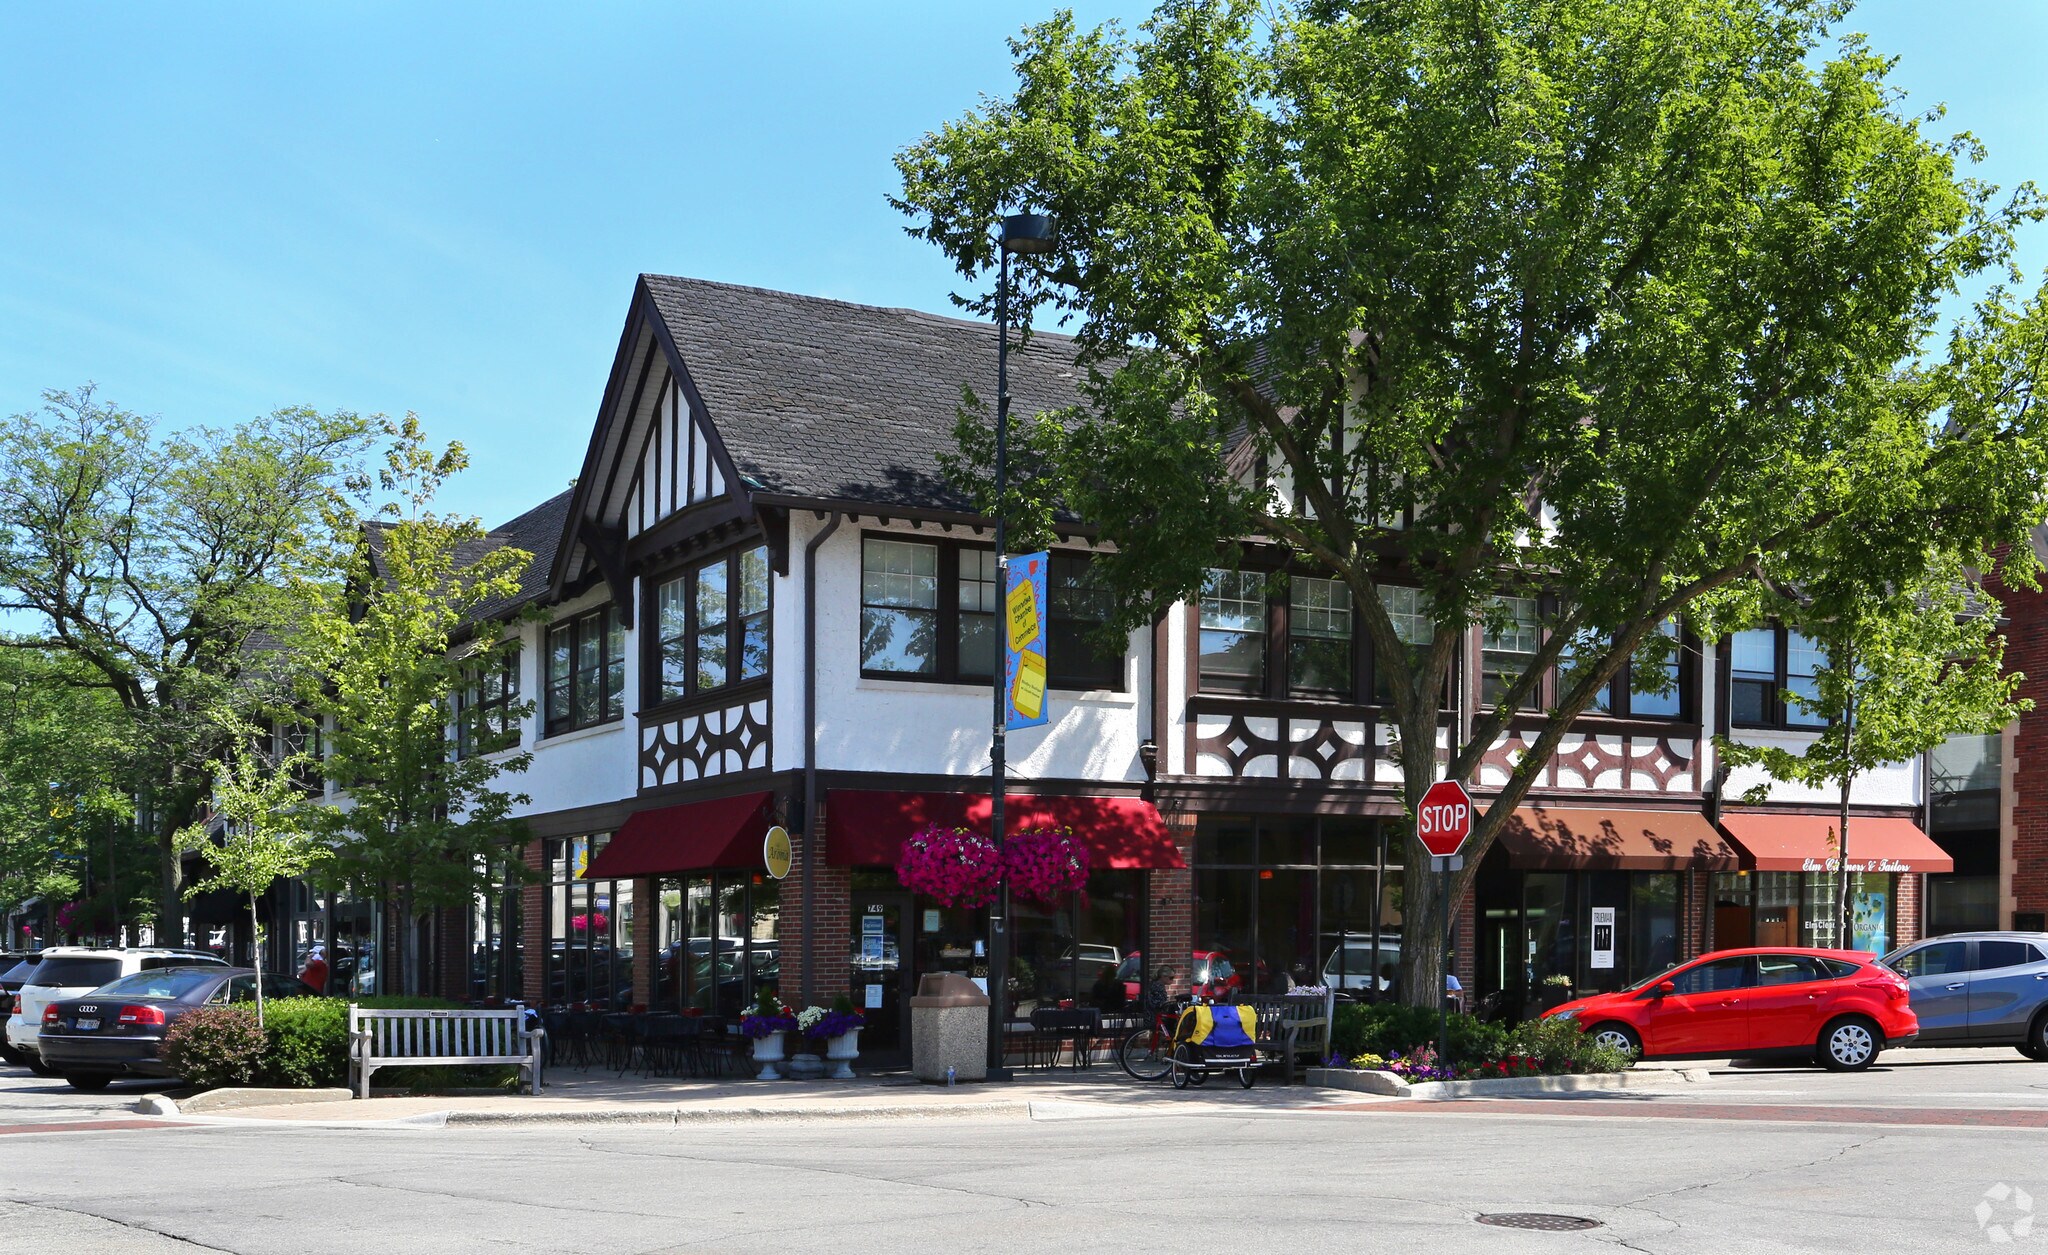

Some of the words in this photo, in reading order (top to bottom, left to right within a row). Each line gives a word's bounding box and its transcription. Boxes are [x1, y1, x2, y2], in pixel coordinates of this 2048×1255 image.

[1014, 604, 1032, 624] Chamber
[1014, 622, 1037, 645] Commerce
[1421, 803, 1467, 834] STOP
[1802, 857, 1823, 871] Elm
[1867, 860, 1877, 872] &
[1878, 858, 1911, 872] Tailors
[868, 904, 884, 913] 749
[1804, 921, 1817, 929] Elm
[1854, 922, 1883, 931] ORGANIC
